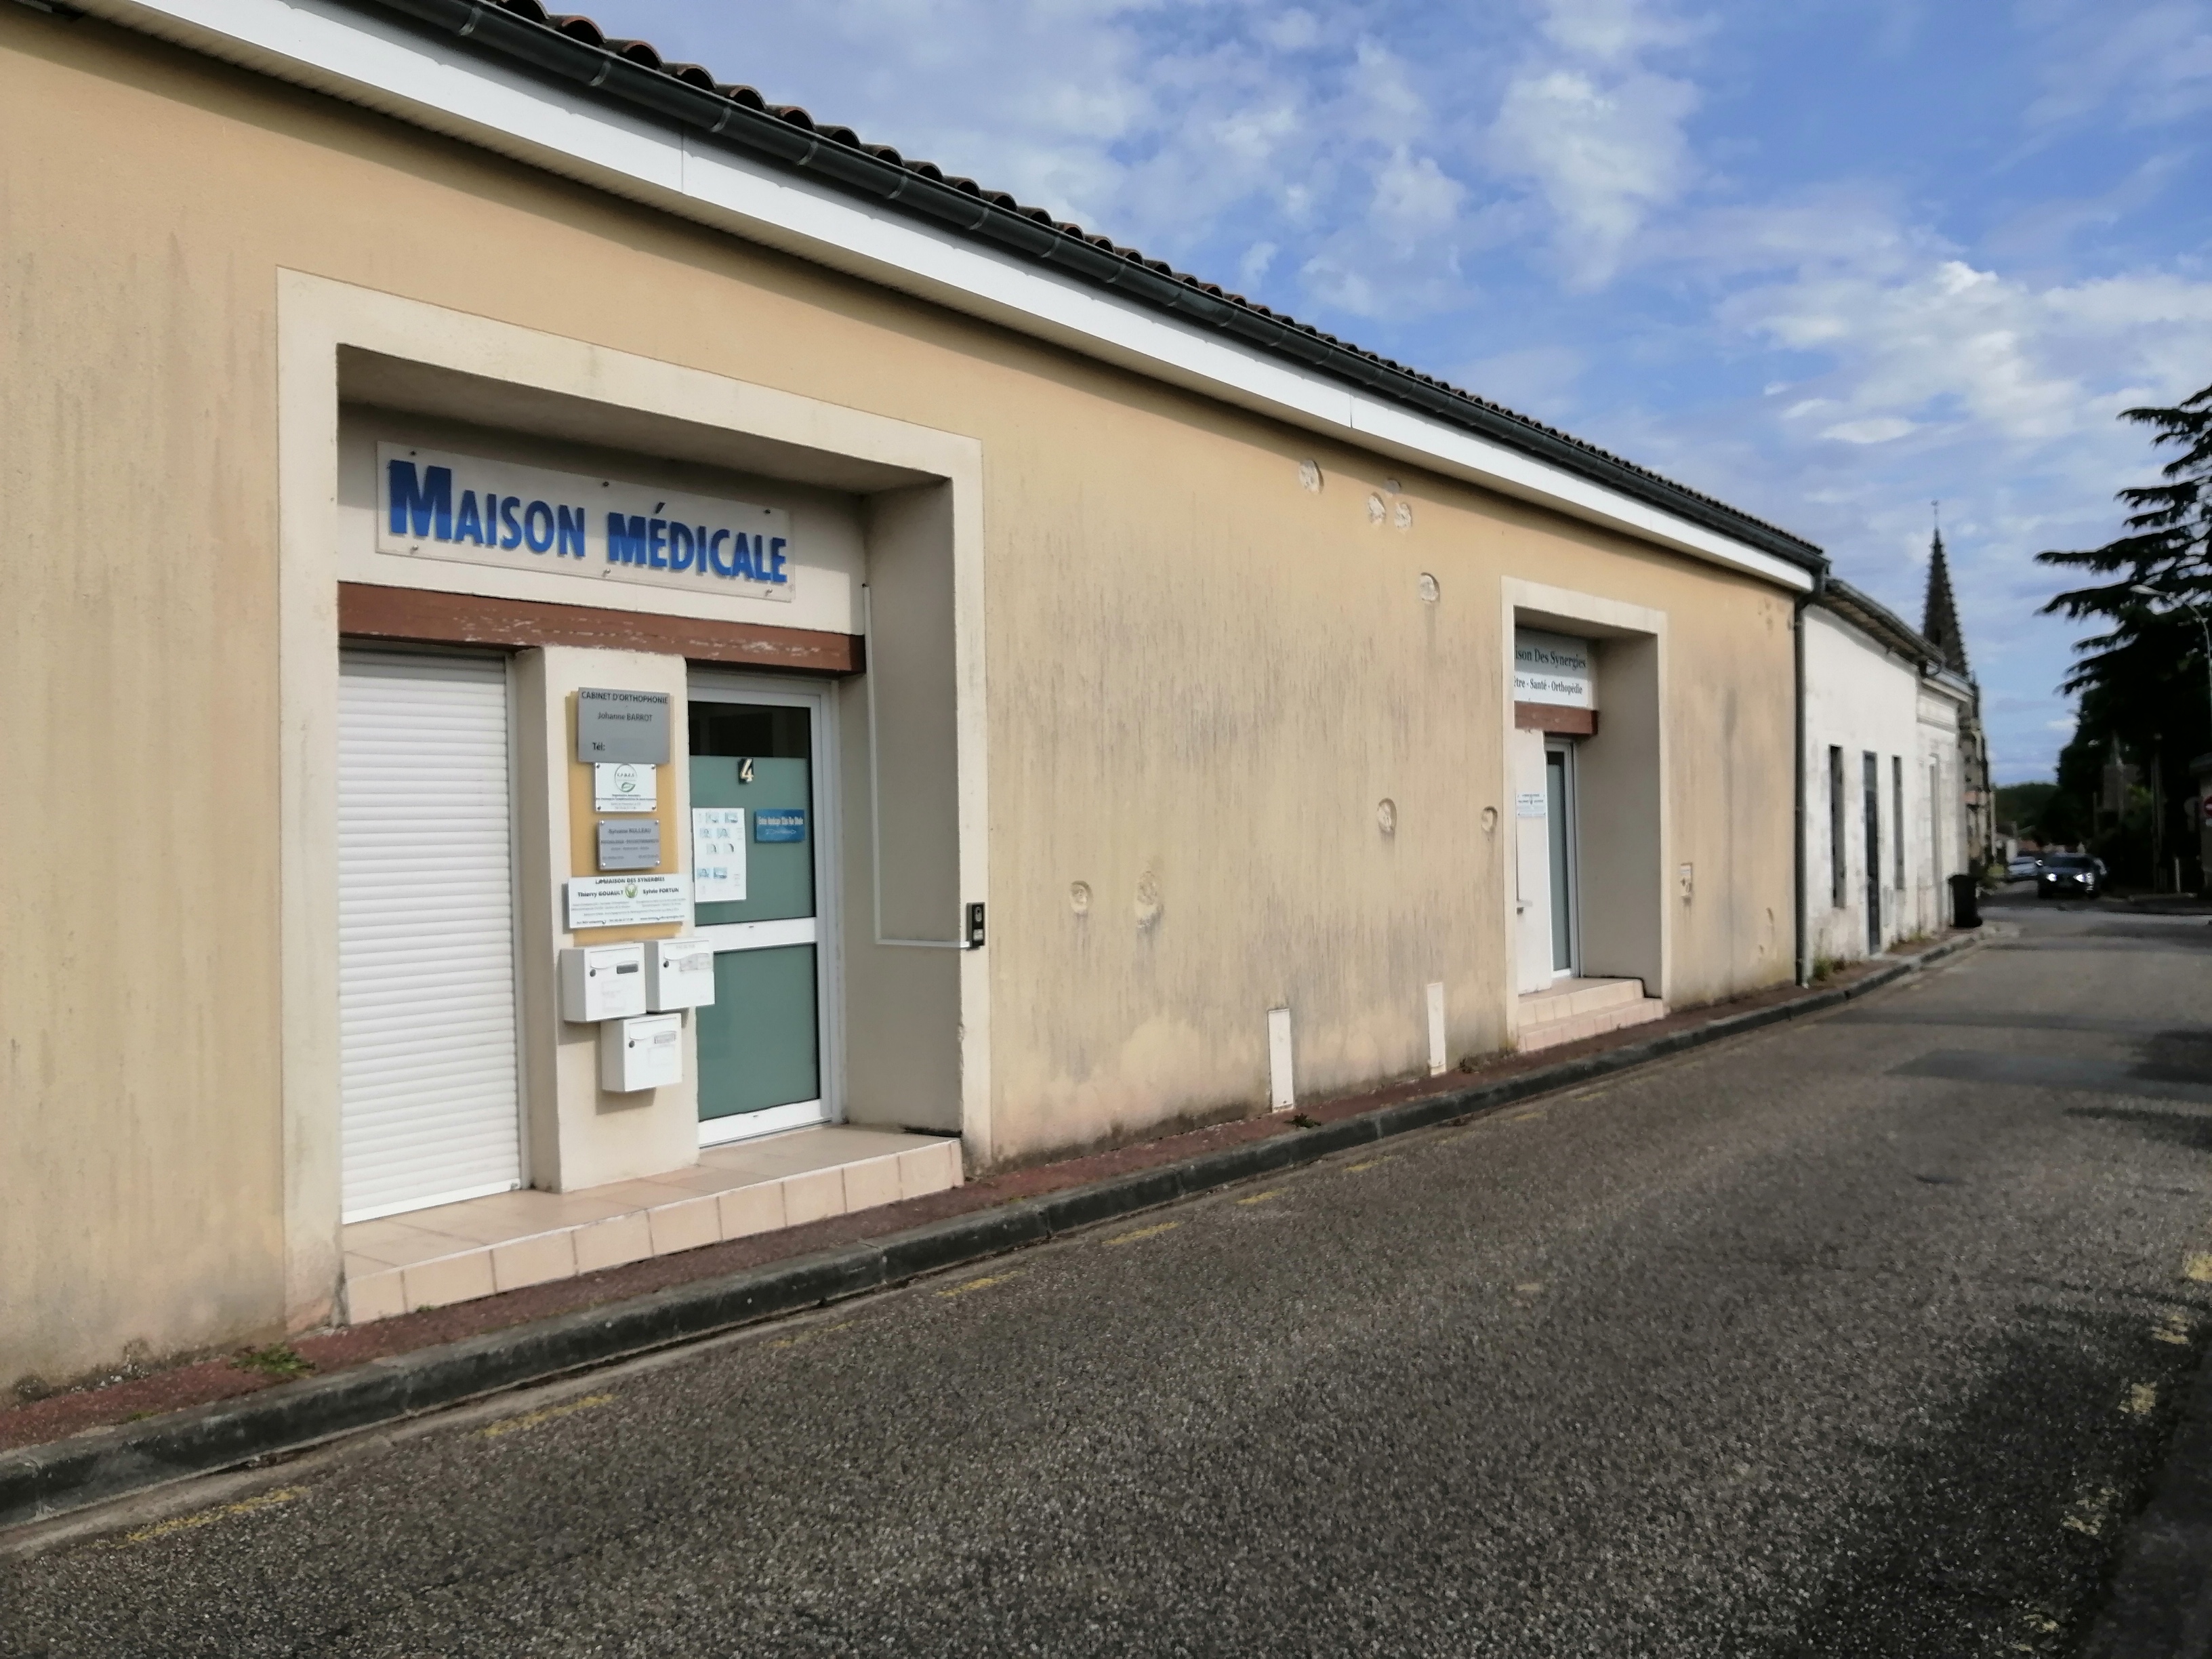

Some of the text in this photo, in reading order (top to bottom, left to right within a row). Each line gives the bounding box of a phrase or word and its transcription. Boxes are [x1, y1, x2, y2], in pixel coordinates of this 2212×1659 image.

[607, 502, 787, 583] MÉDICALE
[1534, 648, 1549, 663] Des
[1550, 651, 1586, 670] Synergies
[1530, 678, 1547, 690] Santé
[1551, 680, 1583, 695] Orthopédie
[581, 691, 668, 704] CABINET D'ORTHOPHONIE
[598, 712, 626, 720] Johanne
[740, 758, 754, 782] 4
